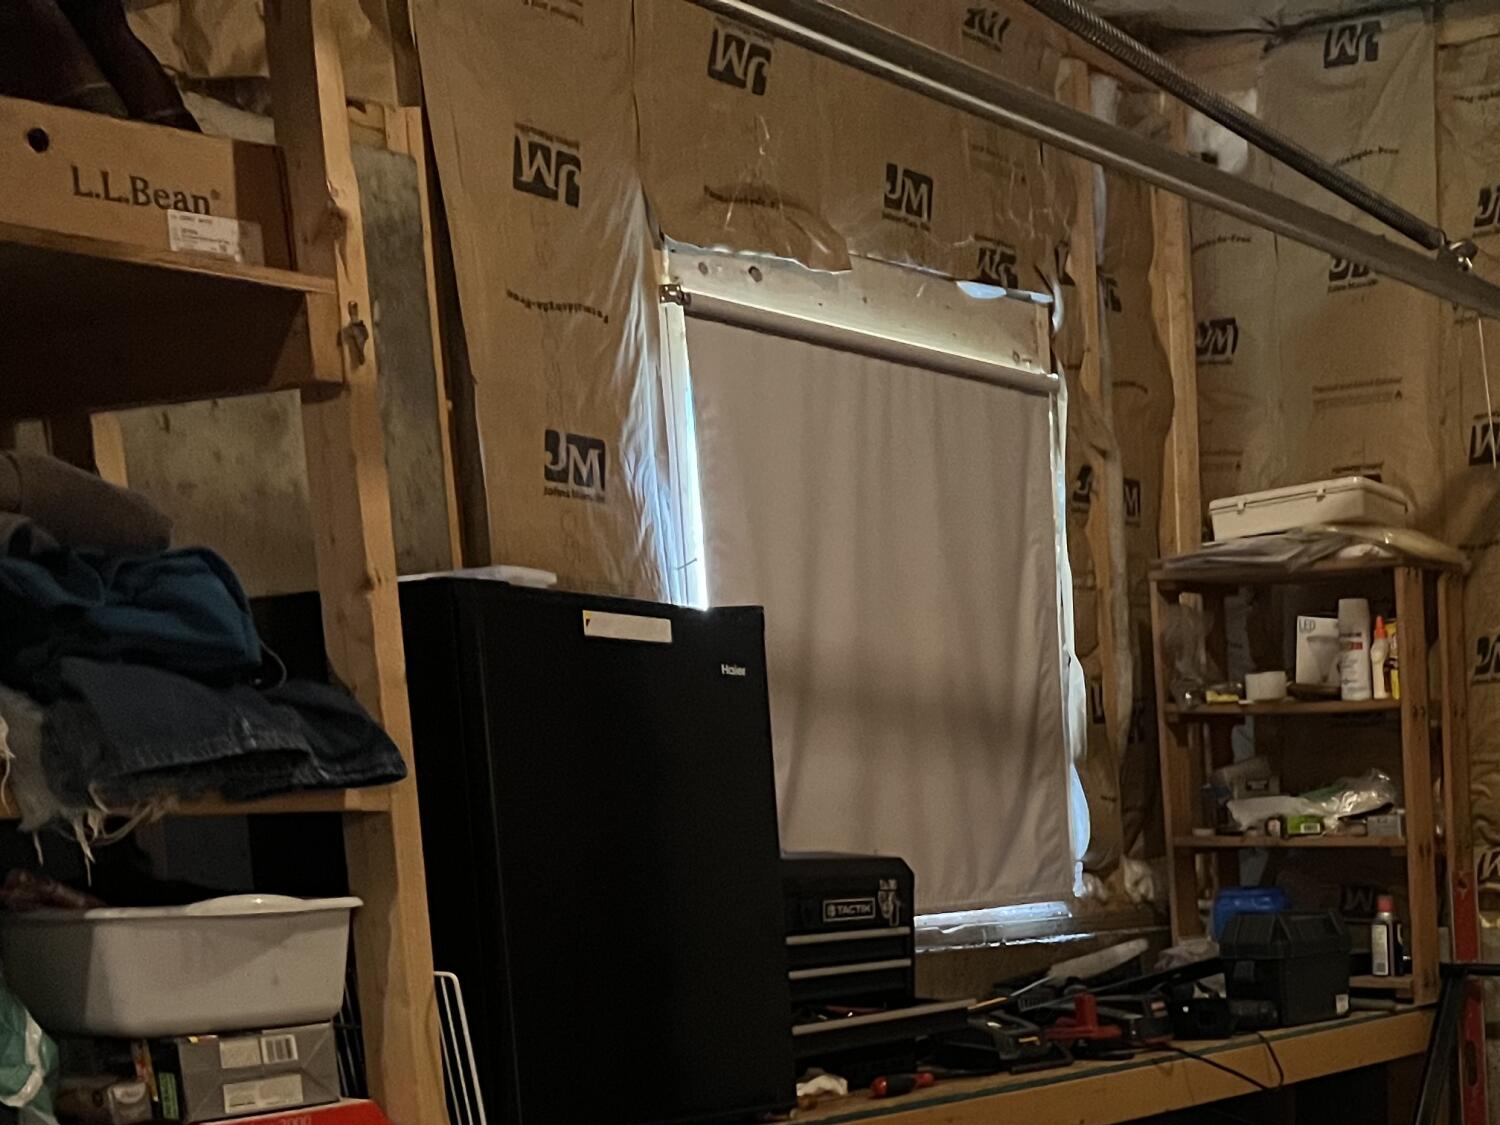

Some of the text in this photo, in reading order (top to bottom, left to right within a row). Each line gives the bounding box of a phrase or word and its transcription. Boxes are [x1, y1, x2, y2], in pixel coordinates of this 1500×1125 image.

[708, 28, 772, 95] JM
[1324, 20, 1382, 68] JM
[513, 135, 581, 208] JM
[885, 163, 934, 223] JM
[544, 429, 606, 491] JM
